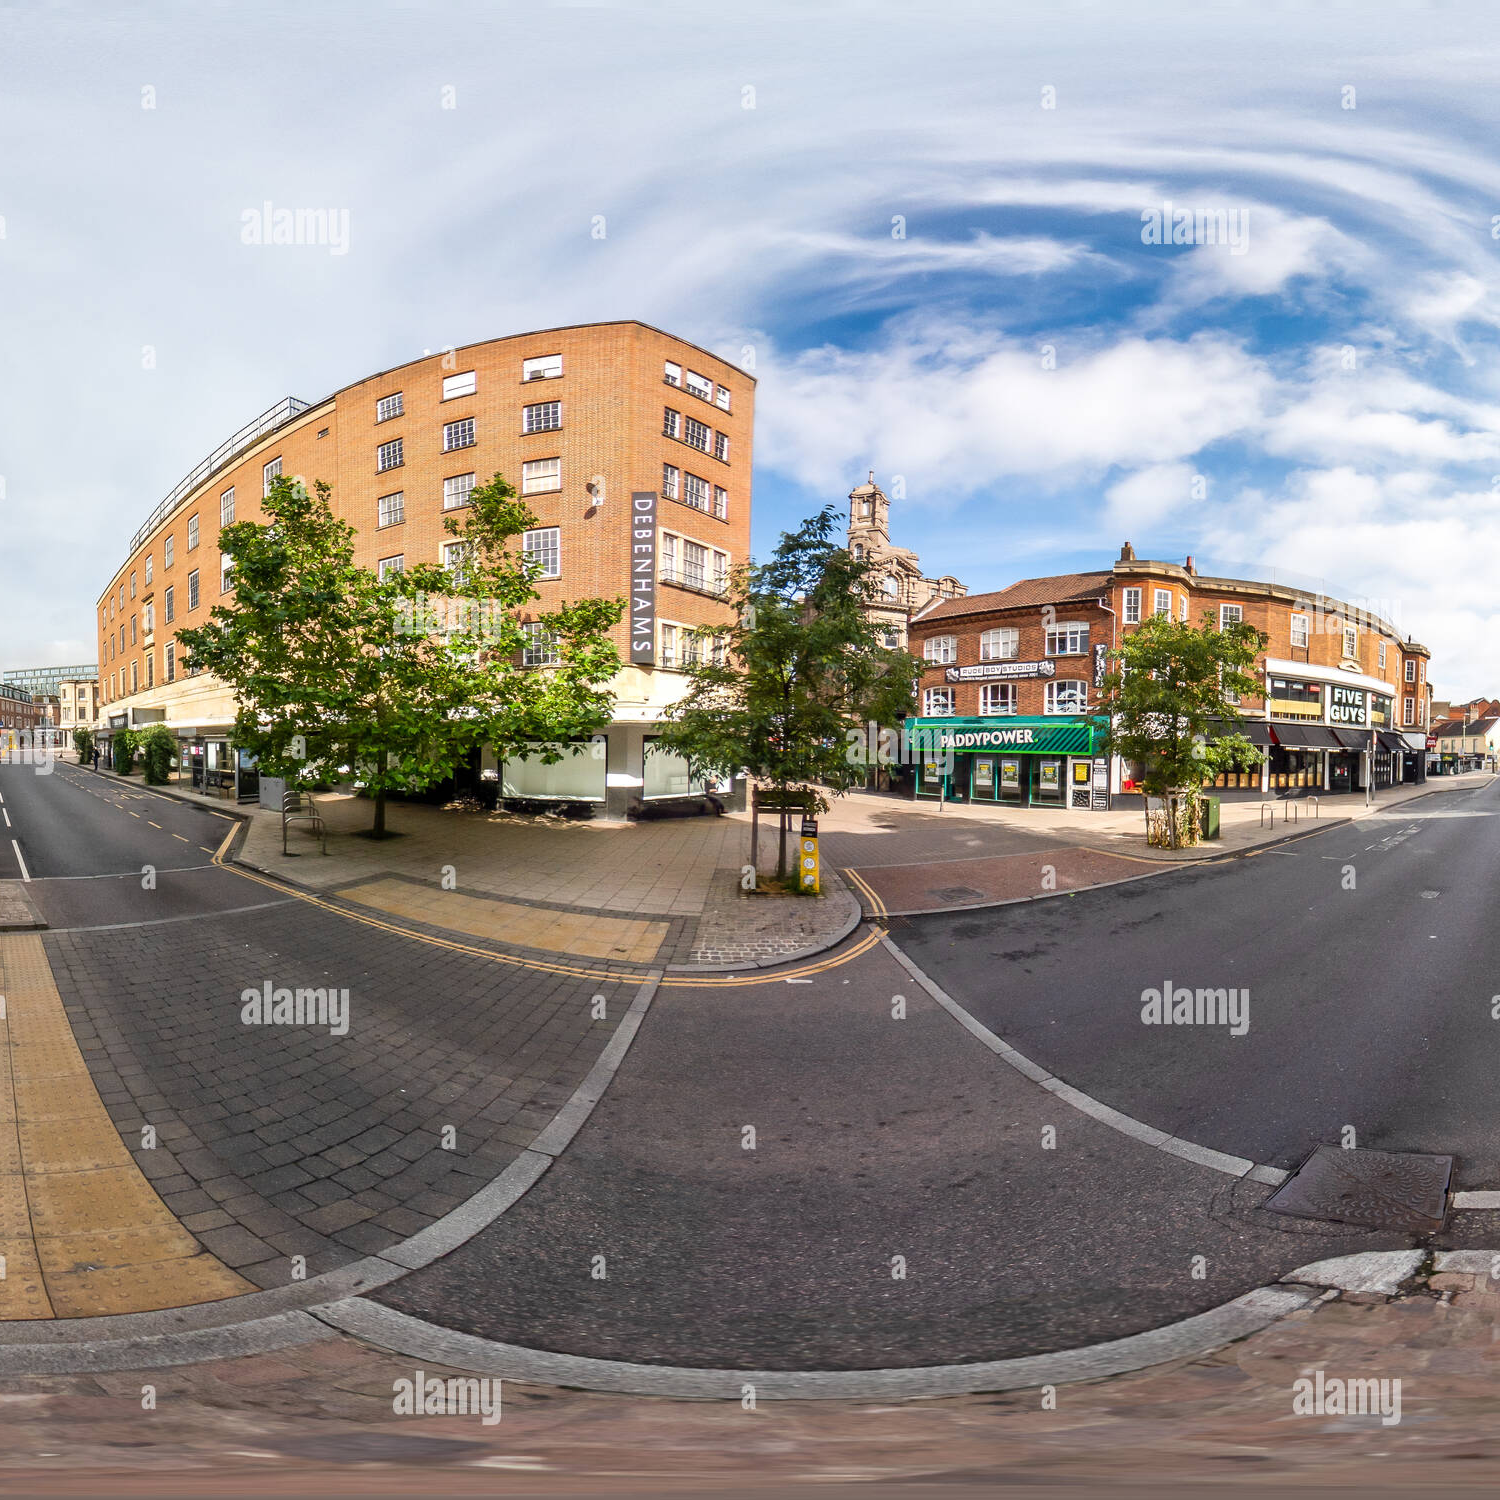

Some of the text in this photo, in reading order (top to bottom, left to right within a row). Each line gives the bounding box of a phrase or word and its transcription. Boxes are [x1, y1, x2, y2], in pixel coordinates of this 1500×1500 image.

[633, 499, 653, 651] DEBENHAMS
[1002, 664, 1037, 672] STUDIOS
[1334, 688, 1363, 706] FIVE
[1330, 706, 1366, 723] GUYS
